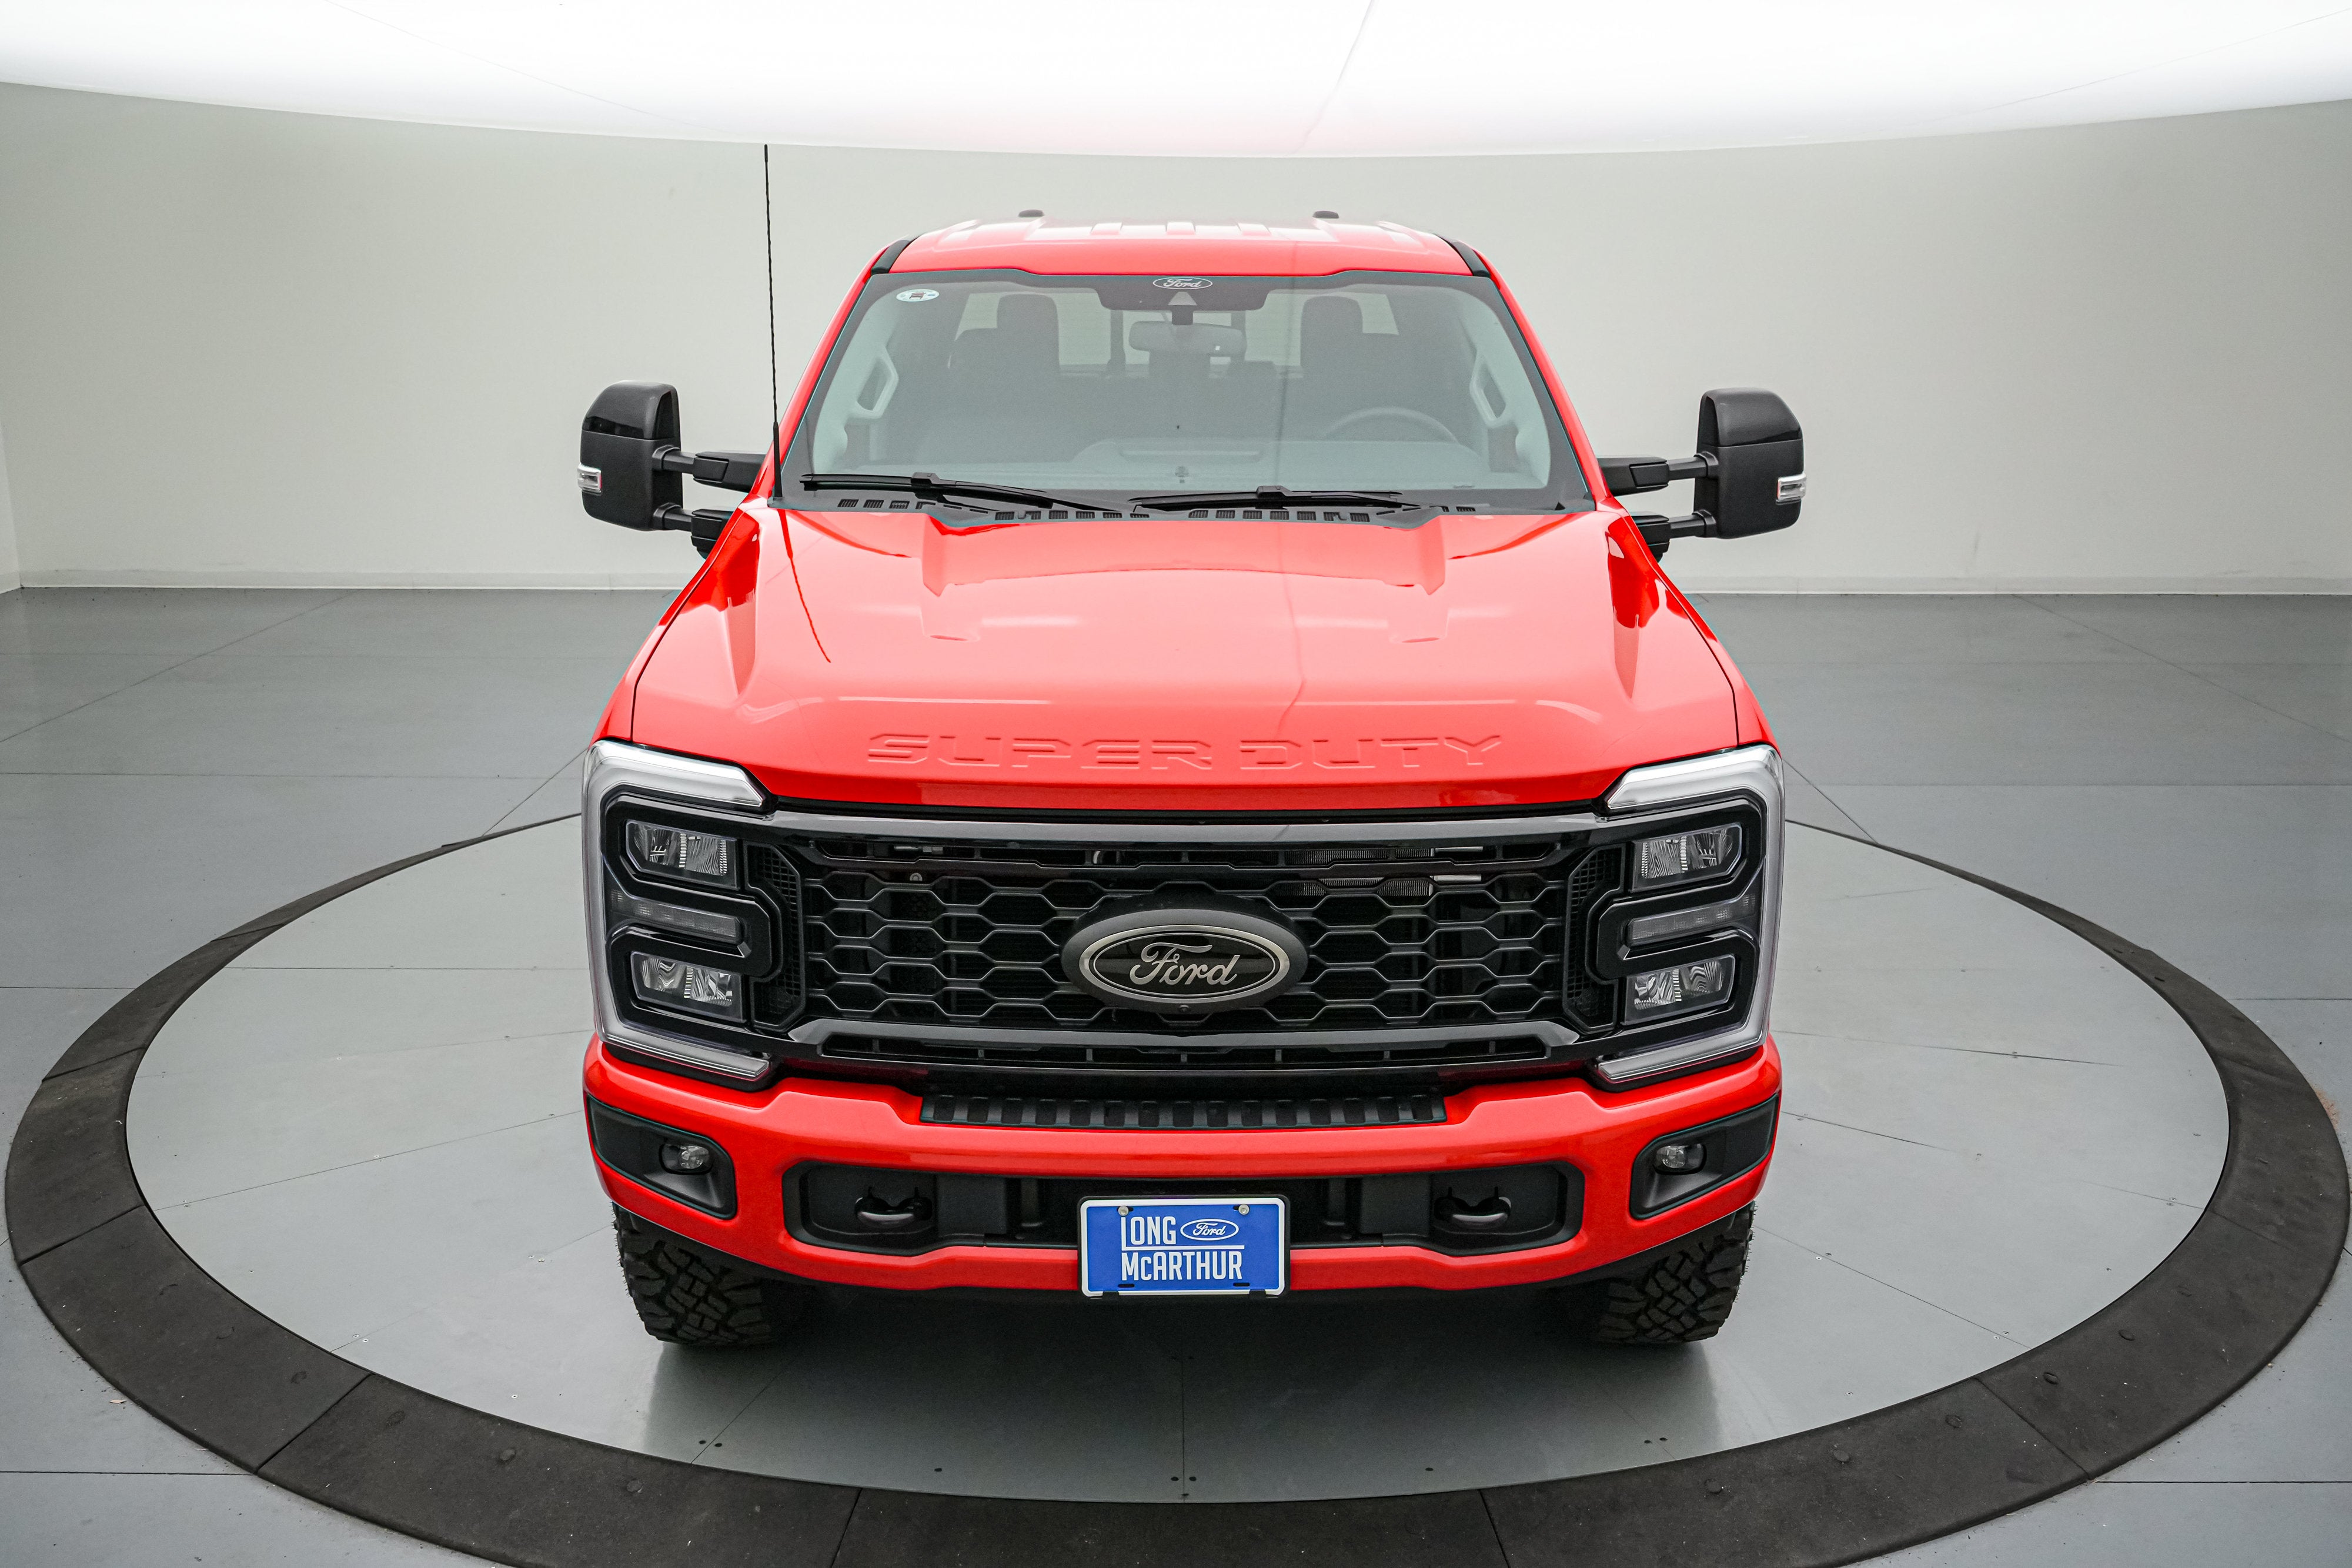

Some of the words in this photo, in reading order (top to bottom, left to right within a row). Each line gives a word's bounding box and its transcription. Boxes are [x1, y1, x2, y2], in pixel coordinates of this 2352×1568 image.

[1163, 279, 1202, 287] Ford
[868, 733, 1212, 769] SUPER
[1240, 735, 1501, 769] DUTY
[1130, 942, 1240, 985] Ford
[1121, 1216, 1177, 1251] LONG
[1192, 1222, 1225, 1236] Ford
[1121, 1251, 1242, 1281] McARTHUR
